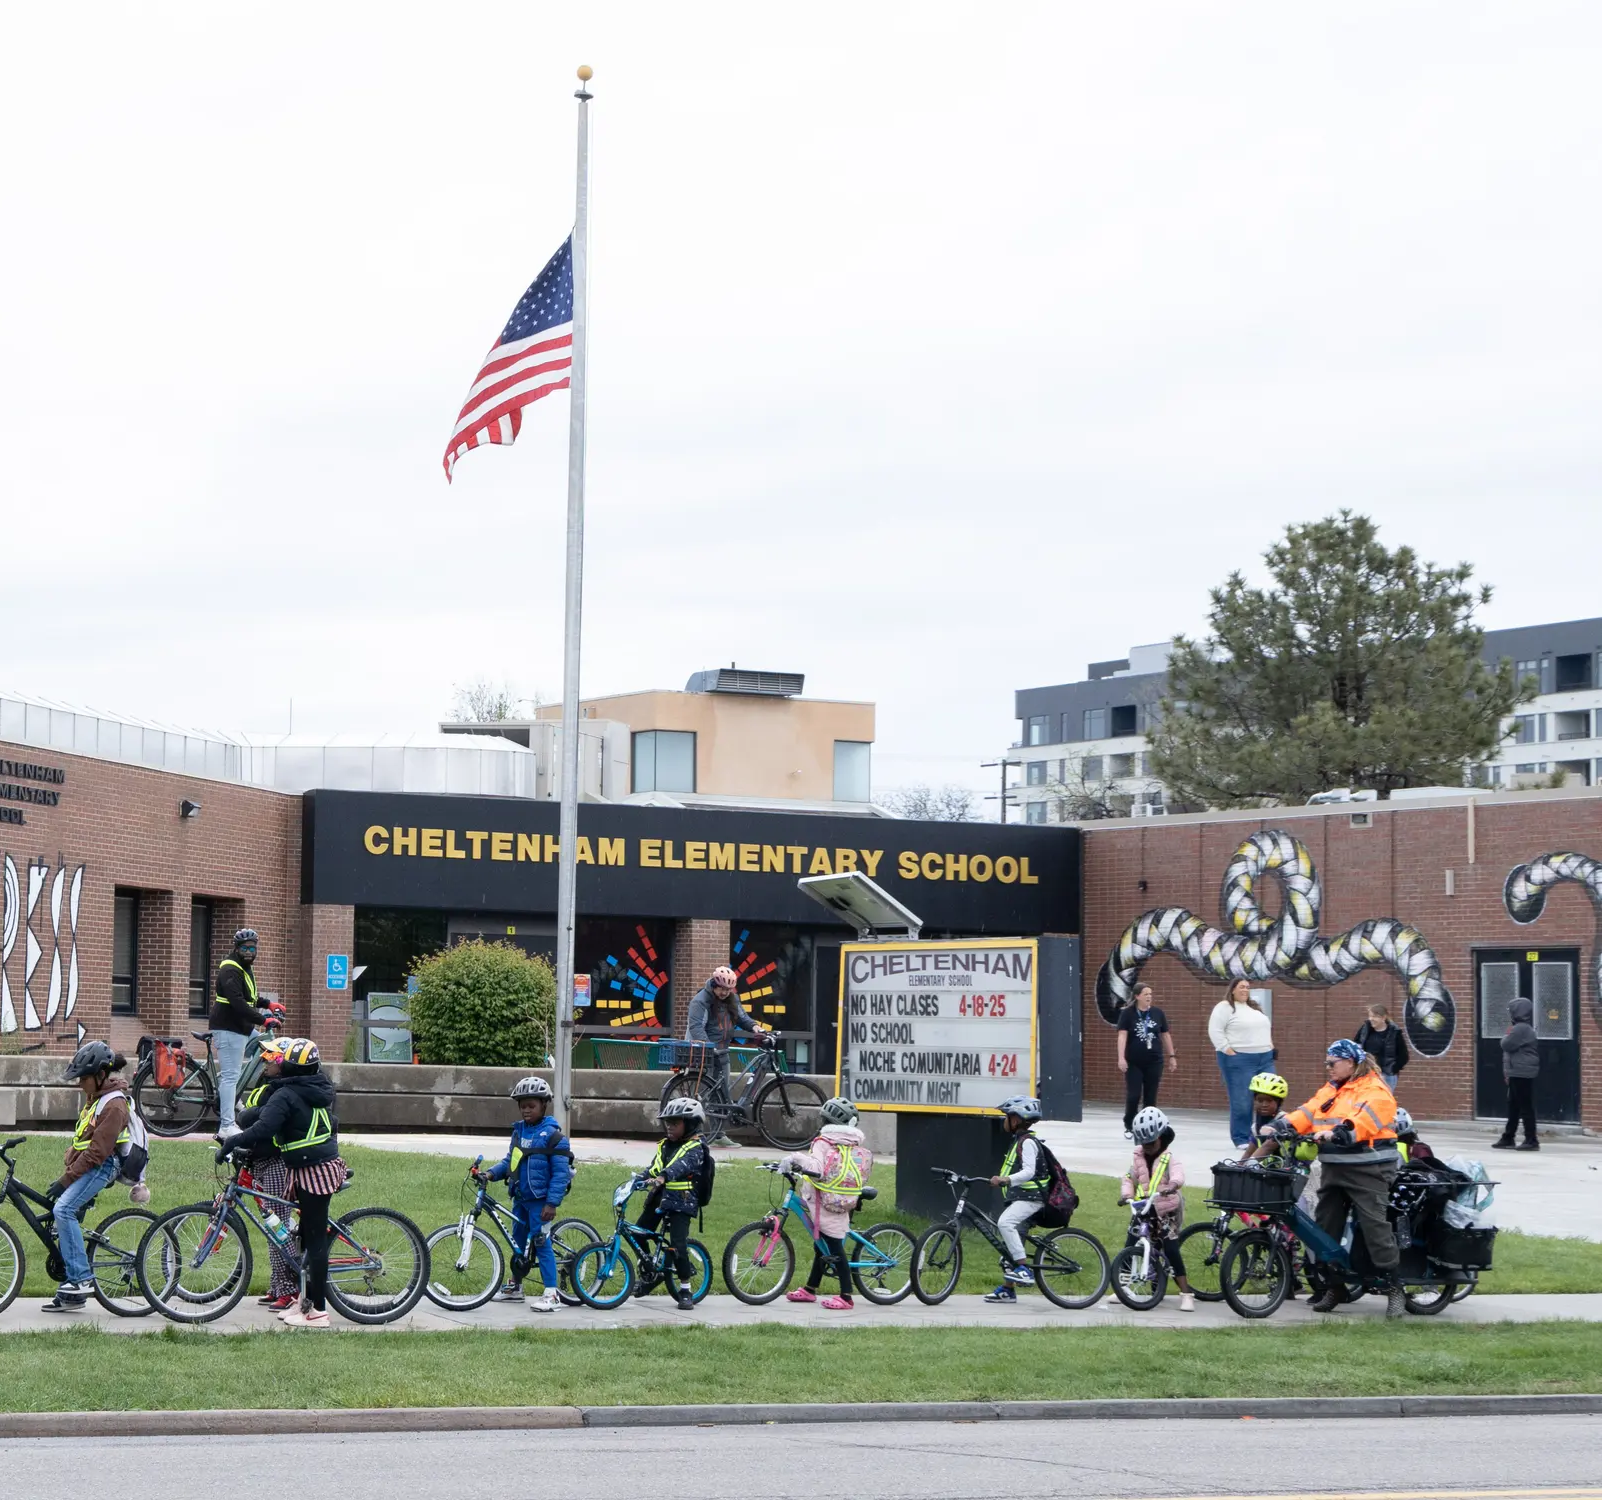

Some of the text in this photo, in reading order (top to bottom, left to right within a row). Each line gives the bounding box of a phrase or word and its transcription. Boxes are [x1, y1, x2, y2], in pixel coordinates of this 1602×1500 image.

[363, 825, 1040, 885] CHELTENHAM ELEMENTARY SCHOOL
[851, 953, 1033, 984] CHELTENHAM
[908, 974, 973, 987] ELEMENTARY SCHOOL
[850, 994, 1006, 1017] NO HAY CLASES 4-18-25
[851, 1022, 915, 1044] NO SCHOOL
[859, 1050, 1017, 1076] NOCHE COMUNITARIA 4-24
[854, 1078, 961, 1104] COMMUNITY NIGHT
